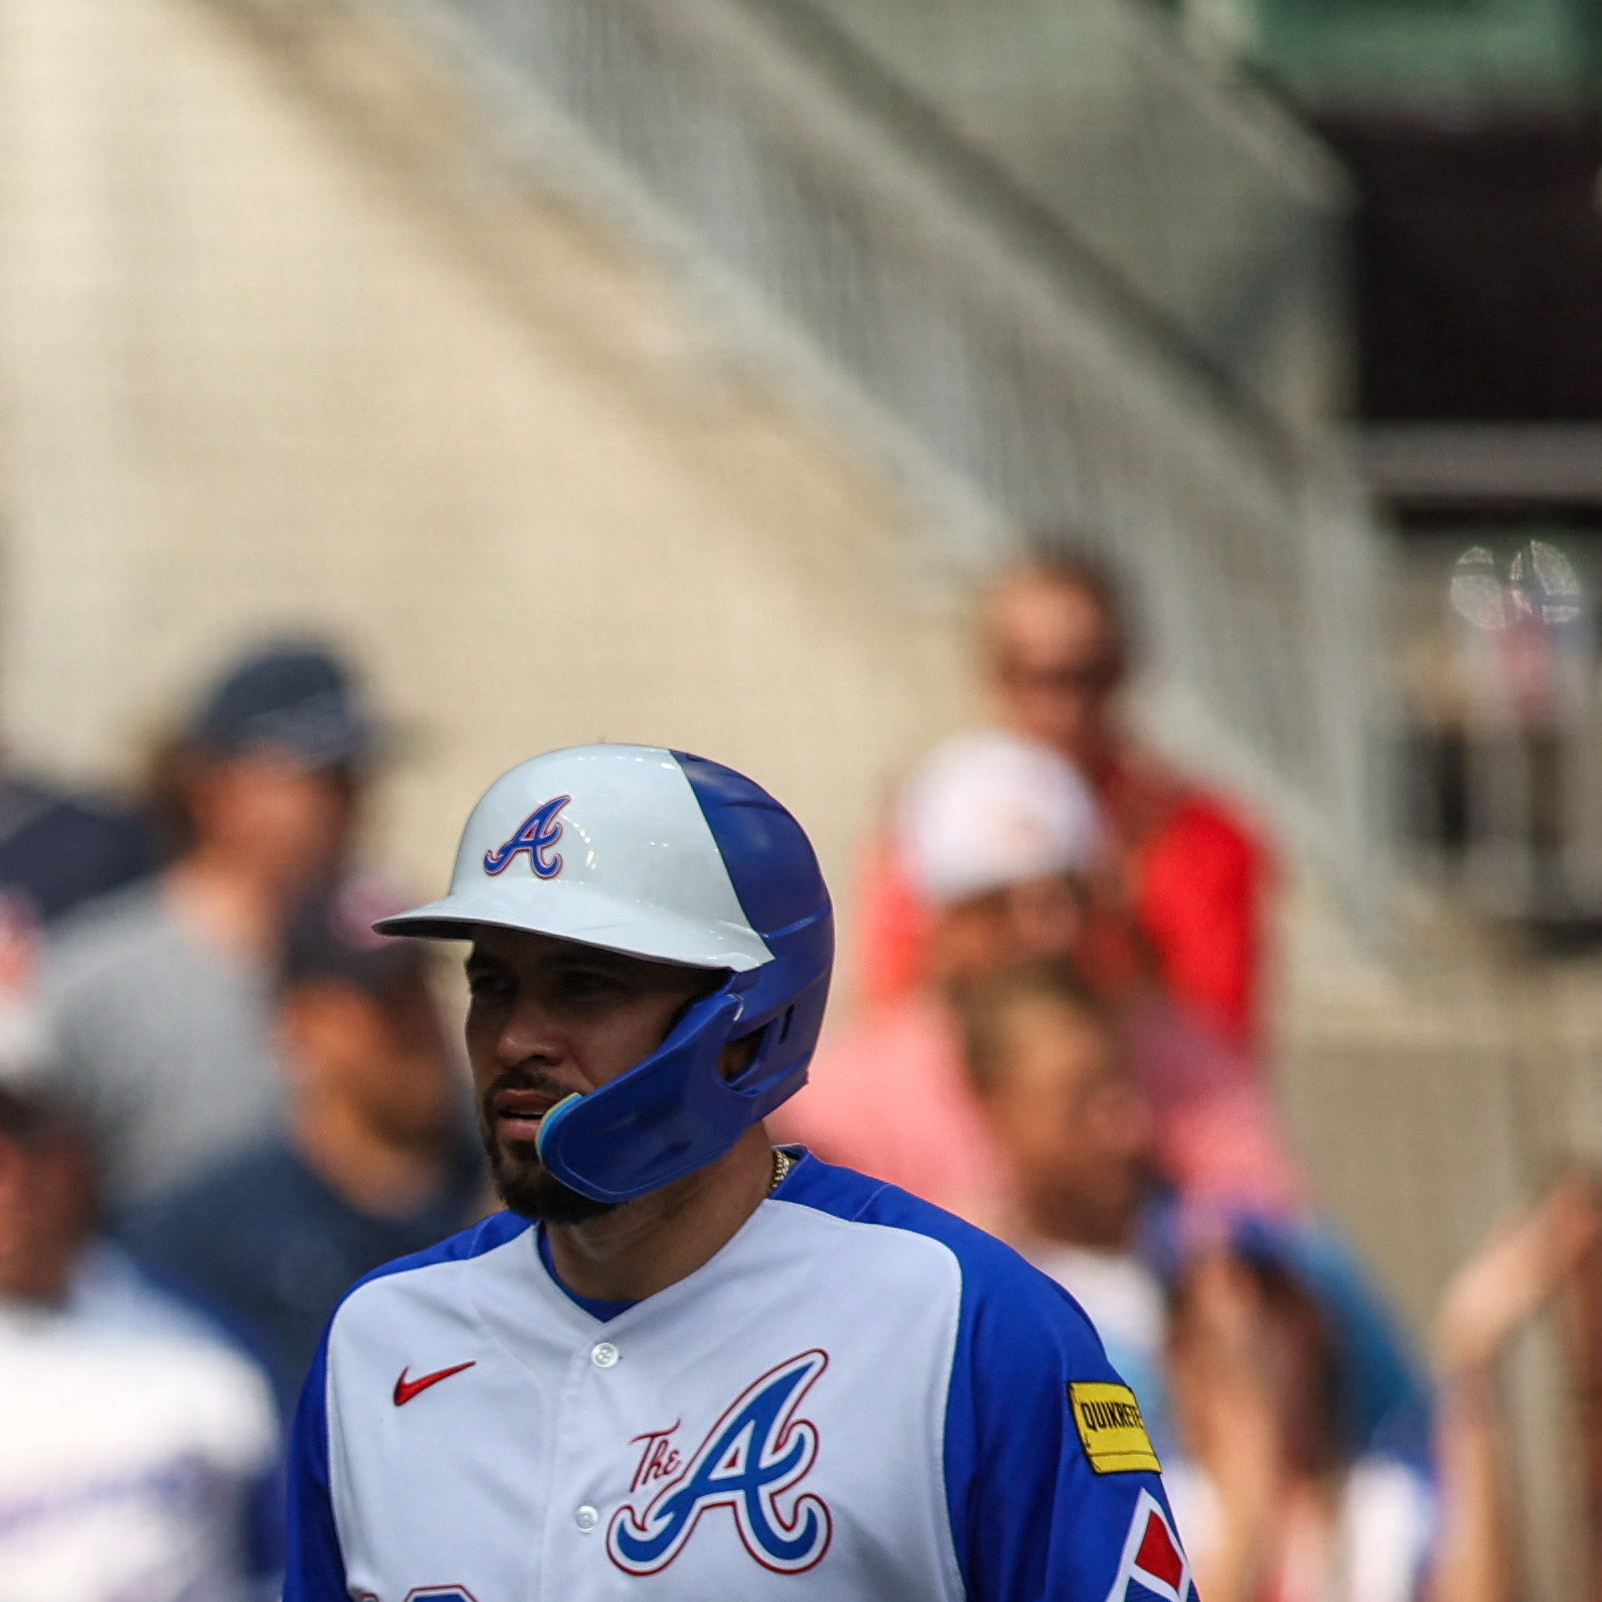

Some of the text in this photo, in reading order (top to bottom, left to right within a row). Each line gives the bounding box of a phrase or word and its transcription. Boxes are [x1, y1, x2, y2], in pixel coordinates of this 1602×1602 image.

[483, 794, 571, 880] A
[605, 1347, 834, 1577] The A
